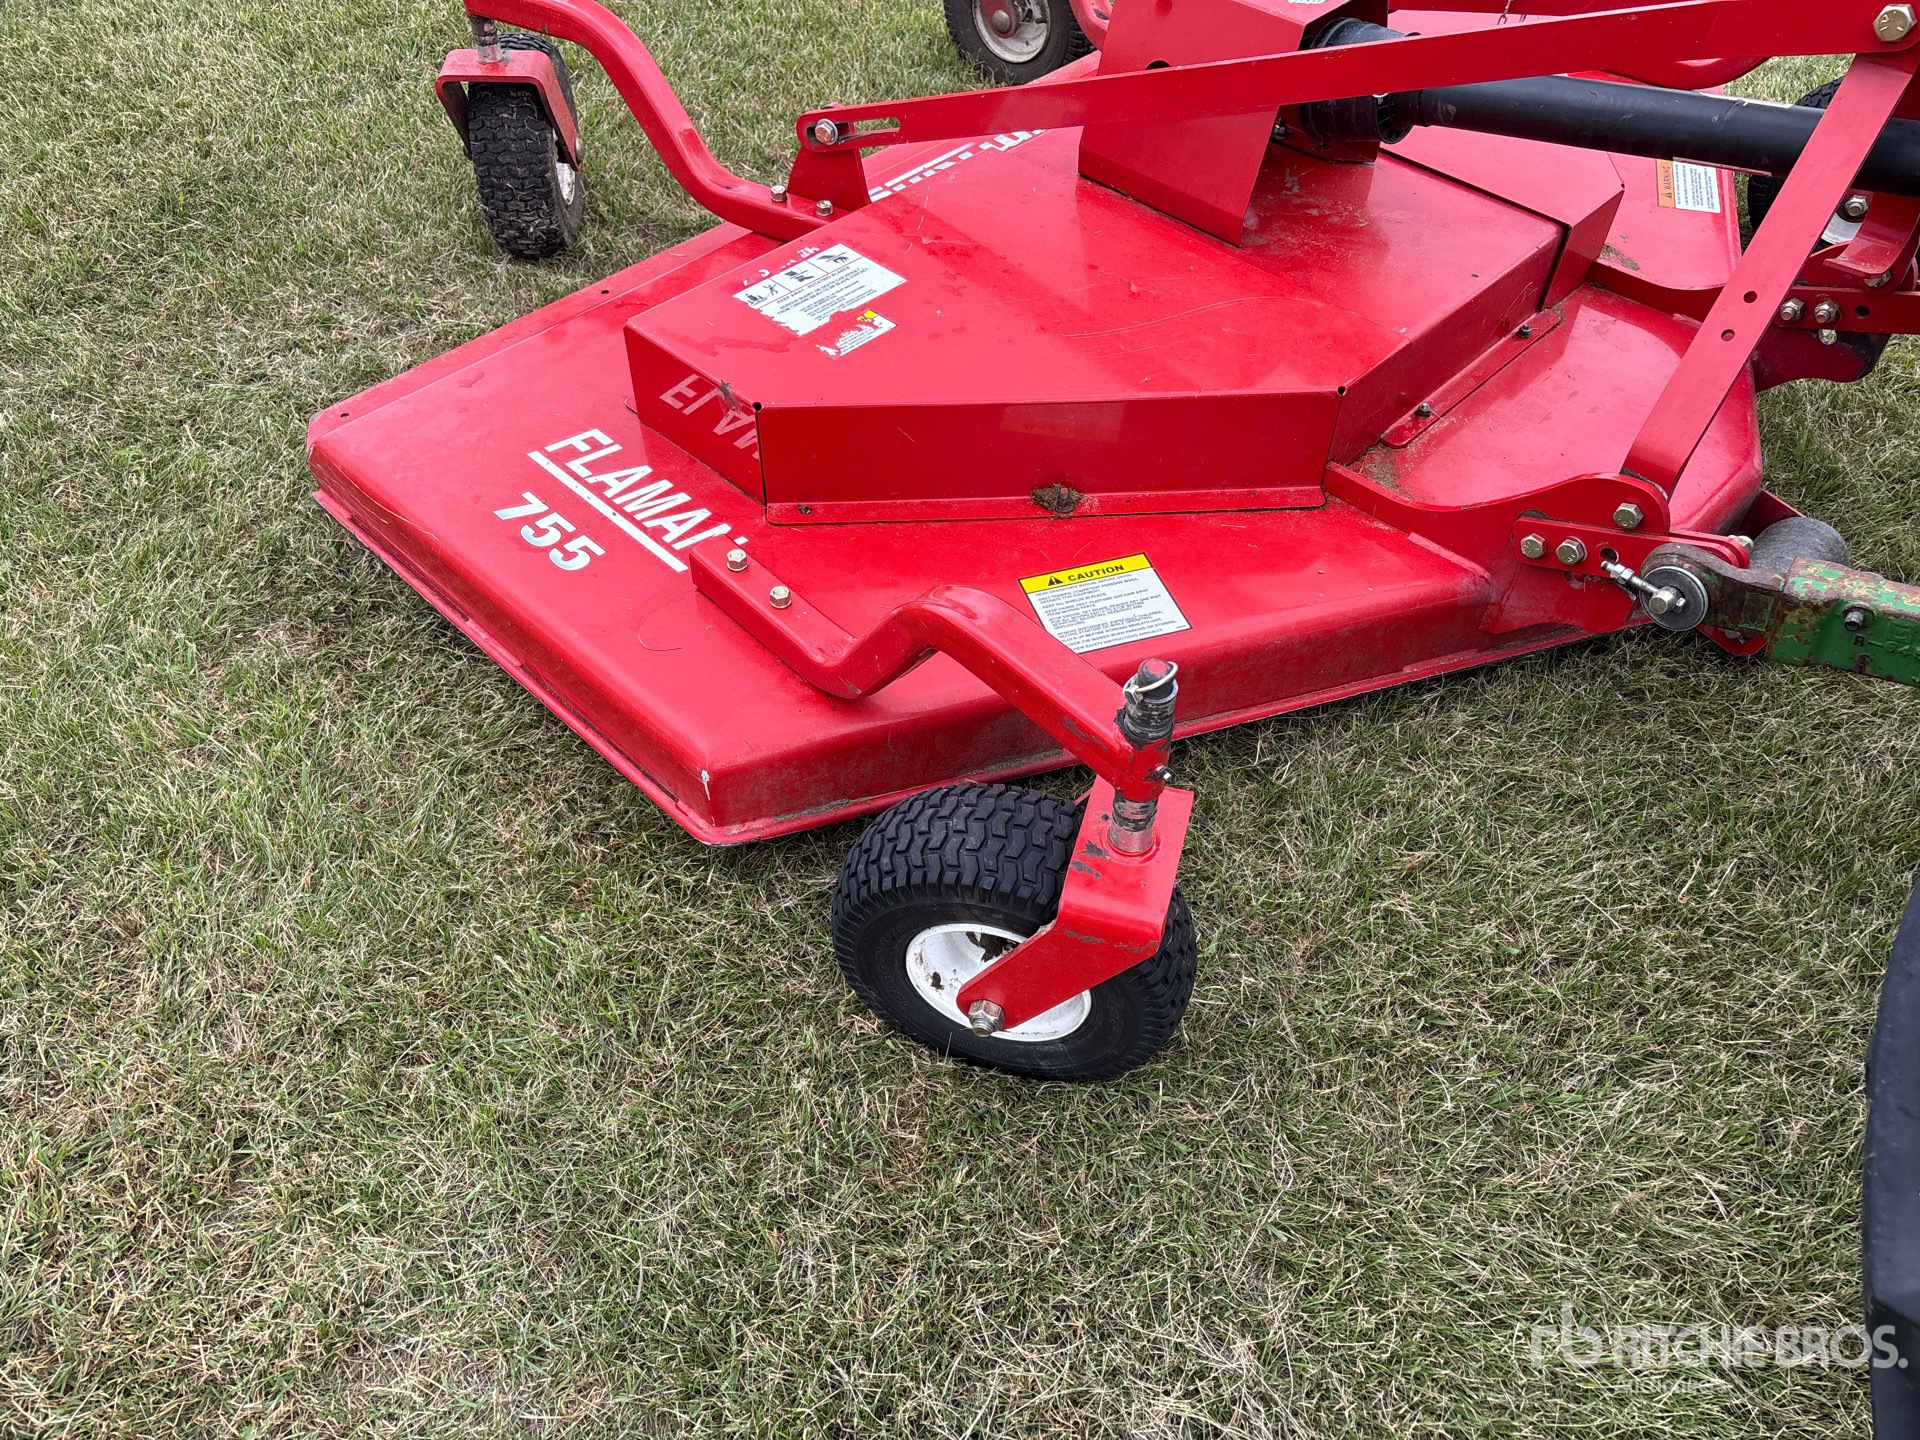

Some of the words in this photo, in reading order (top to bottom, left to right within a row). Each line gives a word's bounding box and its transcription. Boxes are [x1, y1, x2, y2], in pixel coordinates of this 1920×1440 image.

[1662, 165, 1671, 190] WARNING
[492, 490, 607, 571] 755
[1067, 564, 1125, 582] CAUTION
